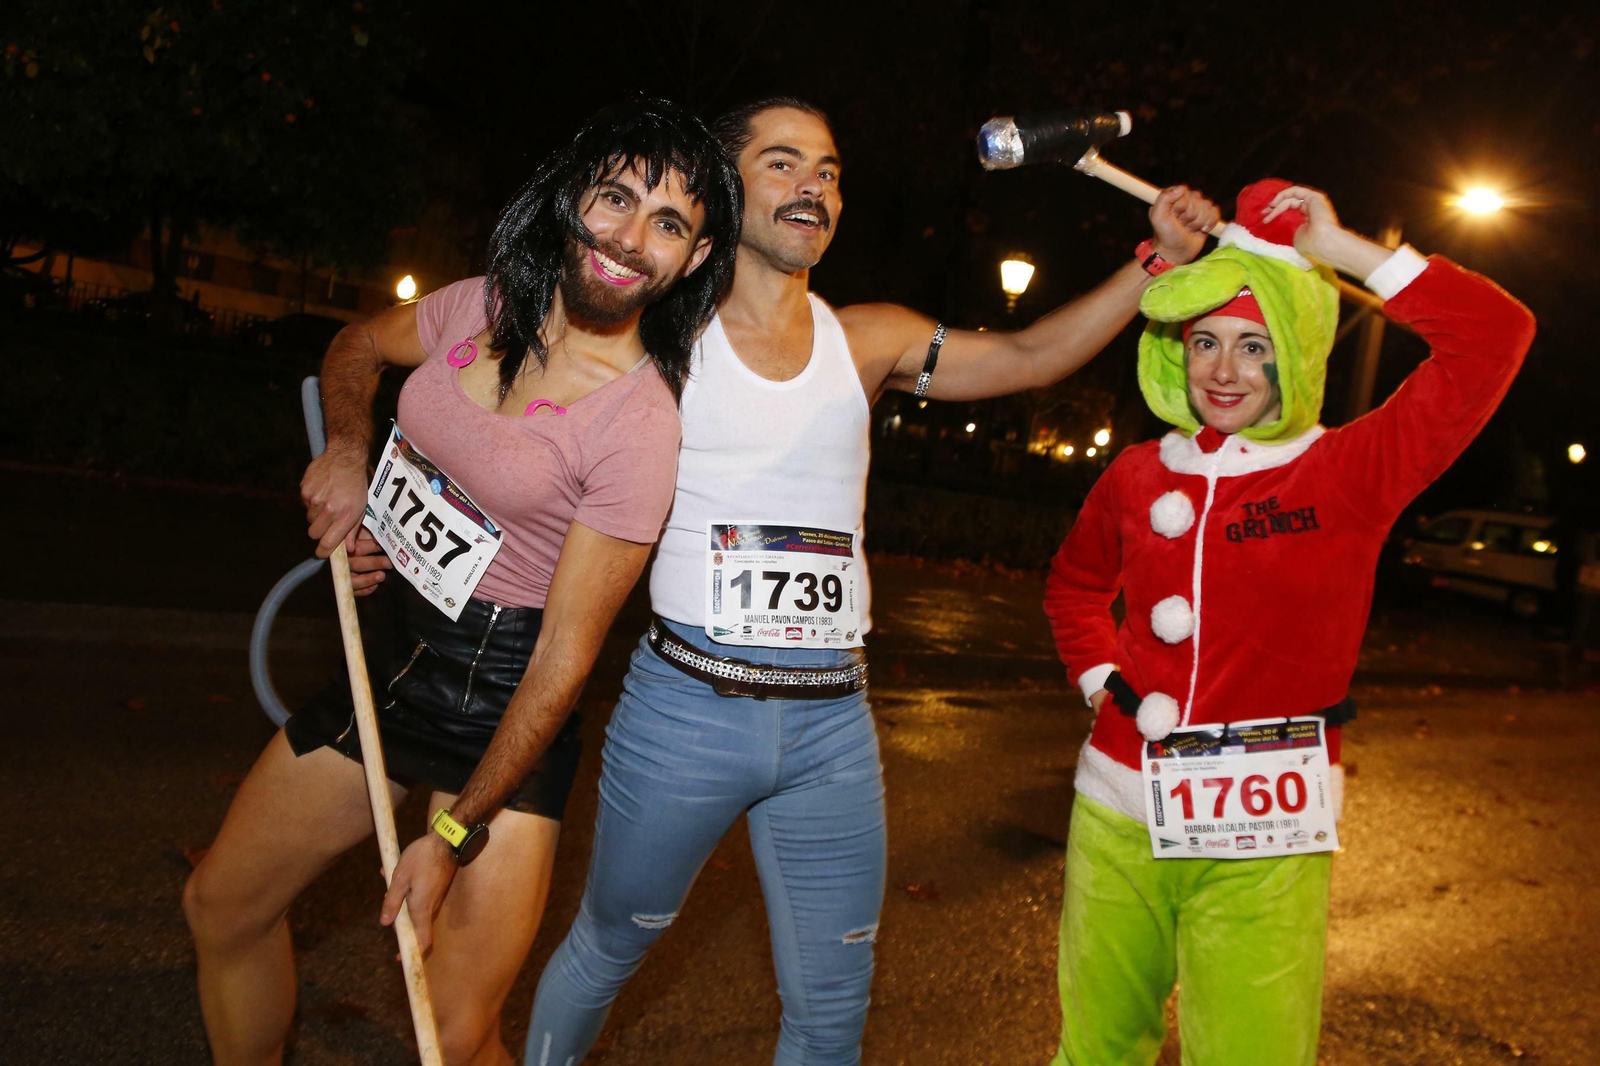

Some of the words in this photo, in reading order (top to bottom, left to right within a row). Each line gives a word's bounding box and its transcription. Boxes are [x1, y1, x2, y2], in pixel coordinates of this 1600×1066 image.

[1242, 496, 1280, 516] THE
[388, 475, 473, 570] 1757
[1226, 507, 1320, 542] GRINCH
[382, 511, 394, 529] DANIEL
[392, 525, 406, 545] CAMPOS
[405, 541, 427, 567] BERNABEU
[464, 563, 478, 586] ABSOLUTA
[731, 570, 842, 613] 1739
[744, 615, 770, 623] MANUEL
[771, 615, 791, 624] PAVON
[792, 616, 814, 625] CAMPOS
[1292, 731, 1316, 739] Granada
[1170, 772, 1307, 820] 1760
[1185, 824, 1216, 834] BARBARA
[1217, 822, 1247, 833] ALCALDE
[1249, 821, 1274, 831] PASTOR
